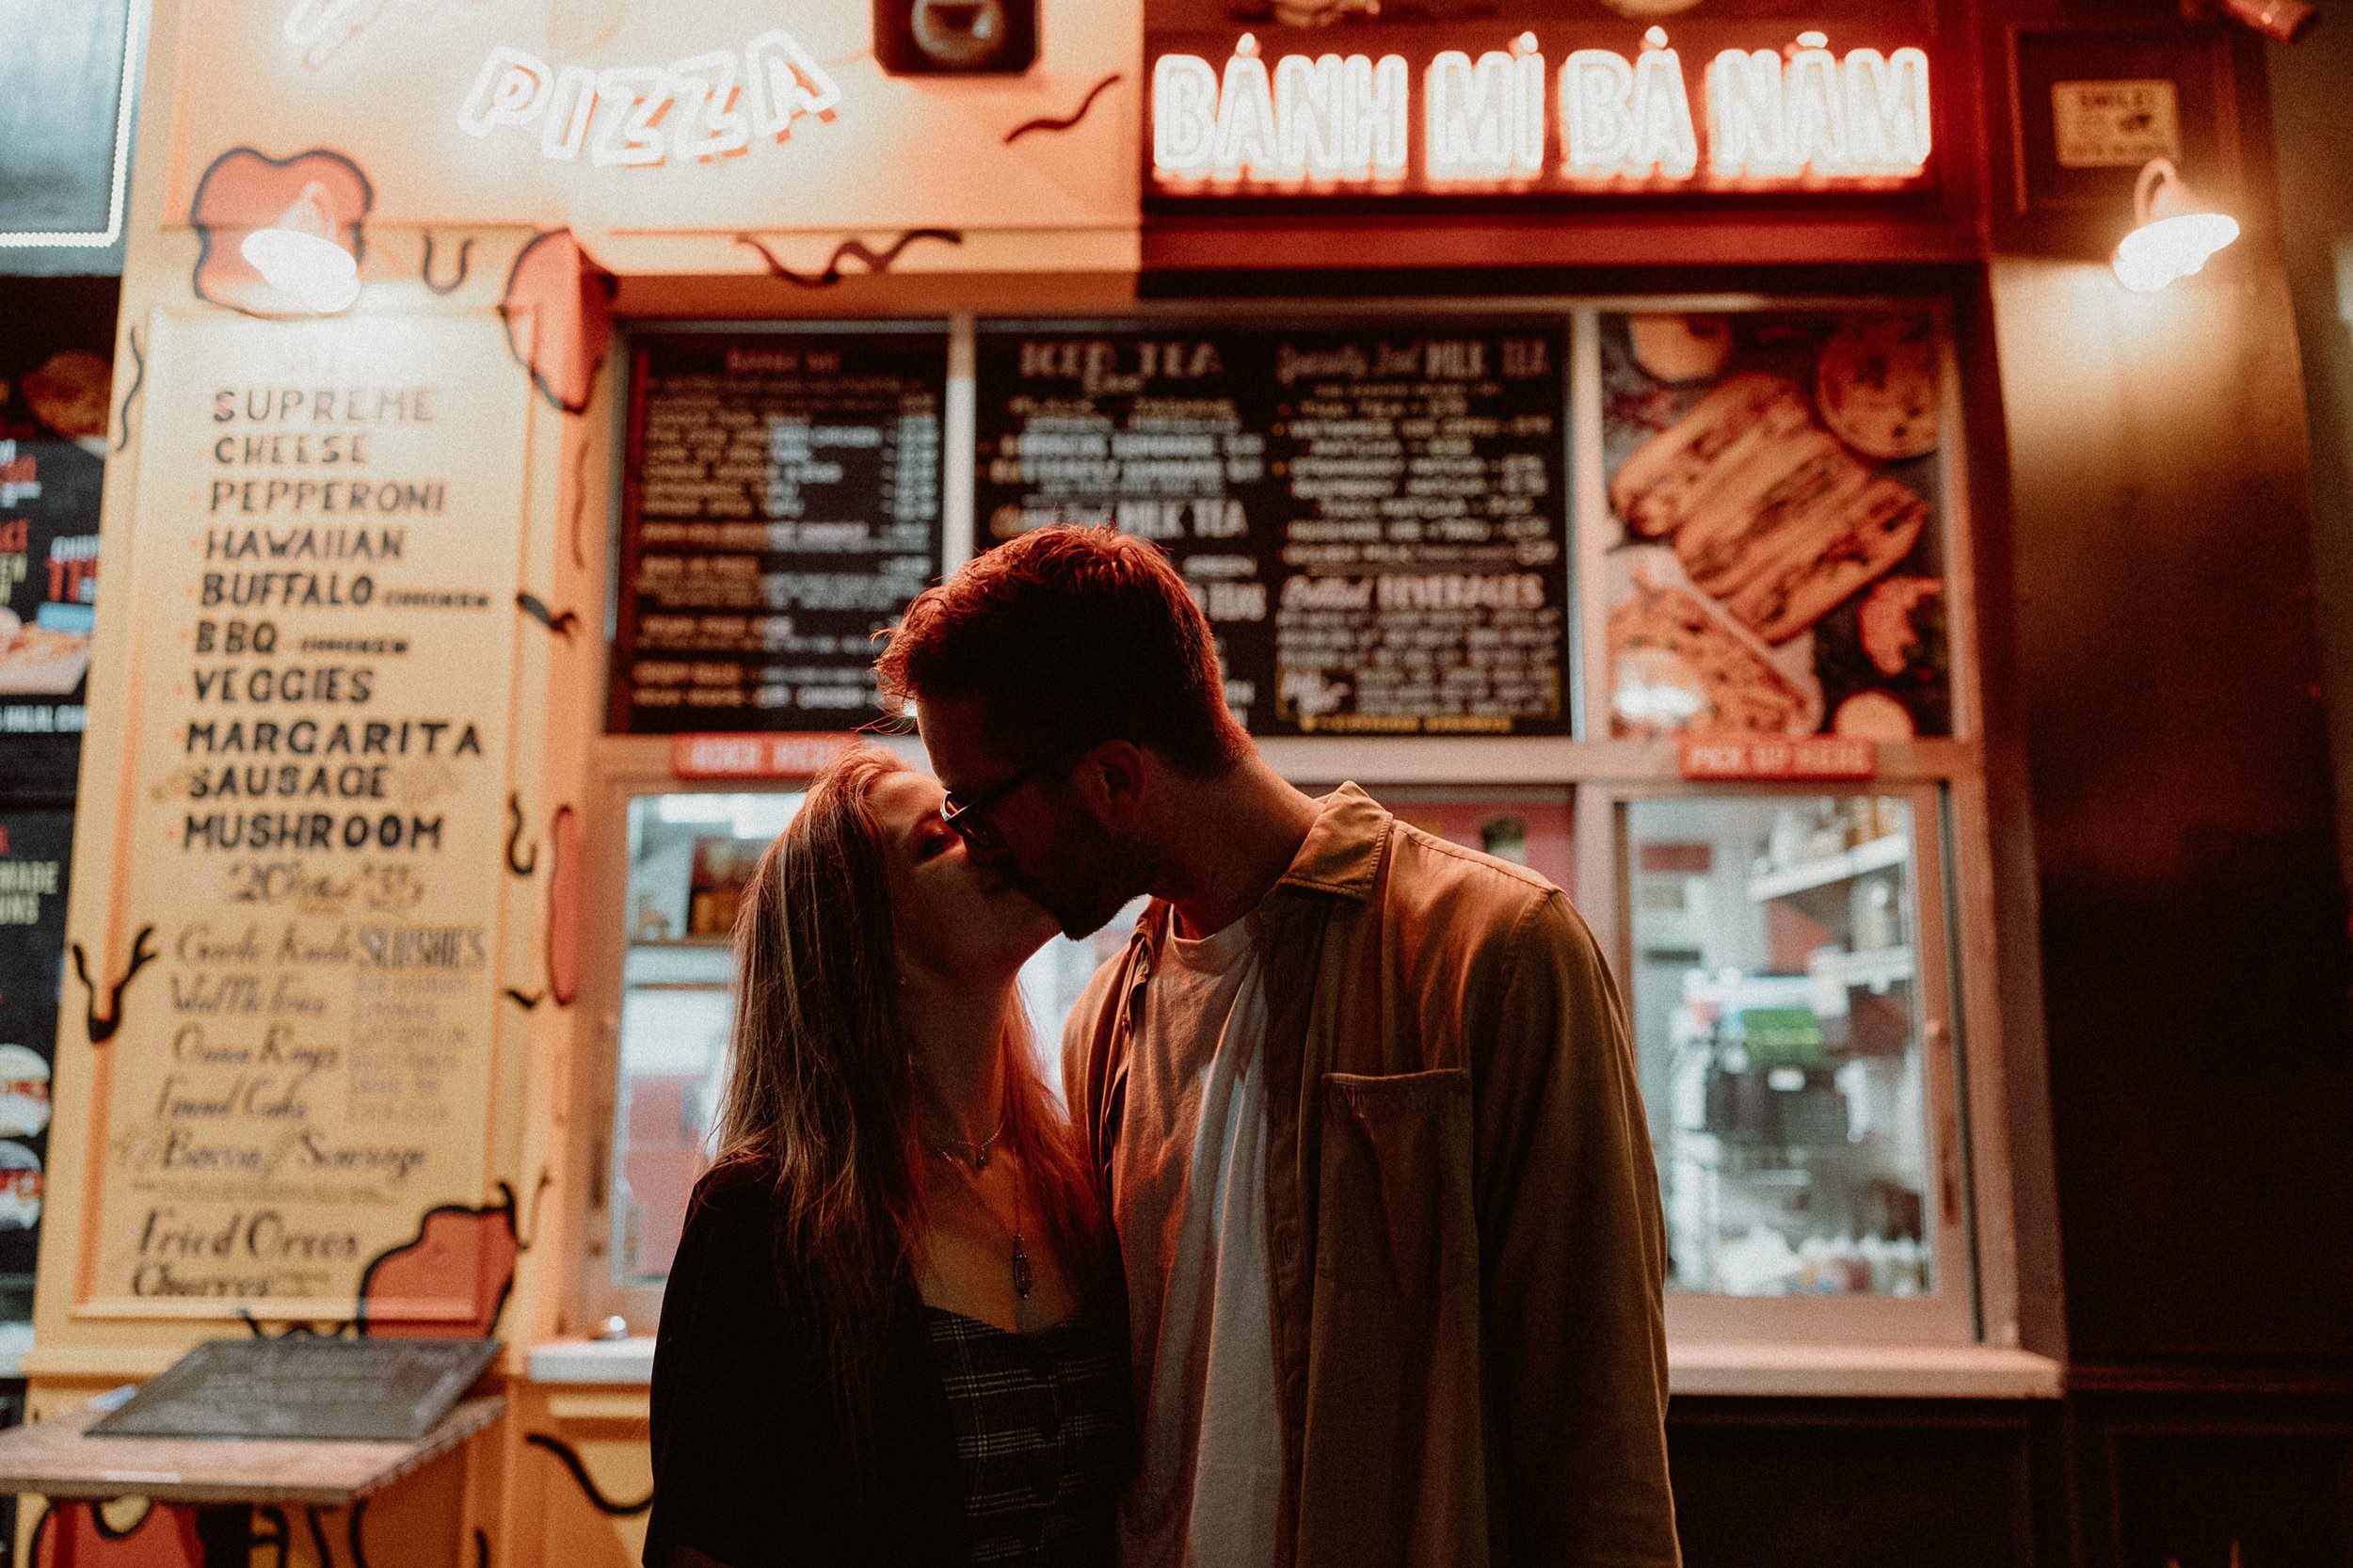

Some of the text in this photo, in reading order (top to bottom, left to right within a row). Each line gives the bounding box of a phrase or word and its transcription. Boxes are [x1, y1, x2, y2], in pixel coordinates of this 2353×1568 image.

[457, 28, 841, 168] PIZZA
[213, 389, 437, 423] SUPREME
[214, 436, 369, 465] CHEESE
[210, 480, 446, 513] PEPPERONI
[205, 529, 404, 560] HAWAIIAN
[200, 572, 374, 607] BUFFALO
[195, 620, 279, 655] BBQ
[193, 667, 374, 703] VEGGIES
[187, 719, 484, 755] MARGARITA
[190, 764, 391, 799] SAUSAGE
[184, 813, 442, 849] MUSHROOM
